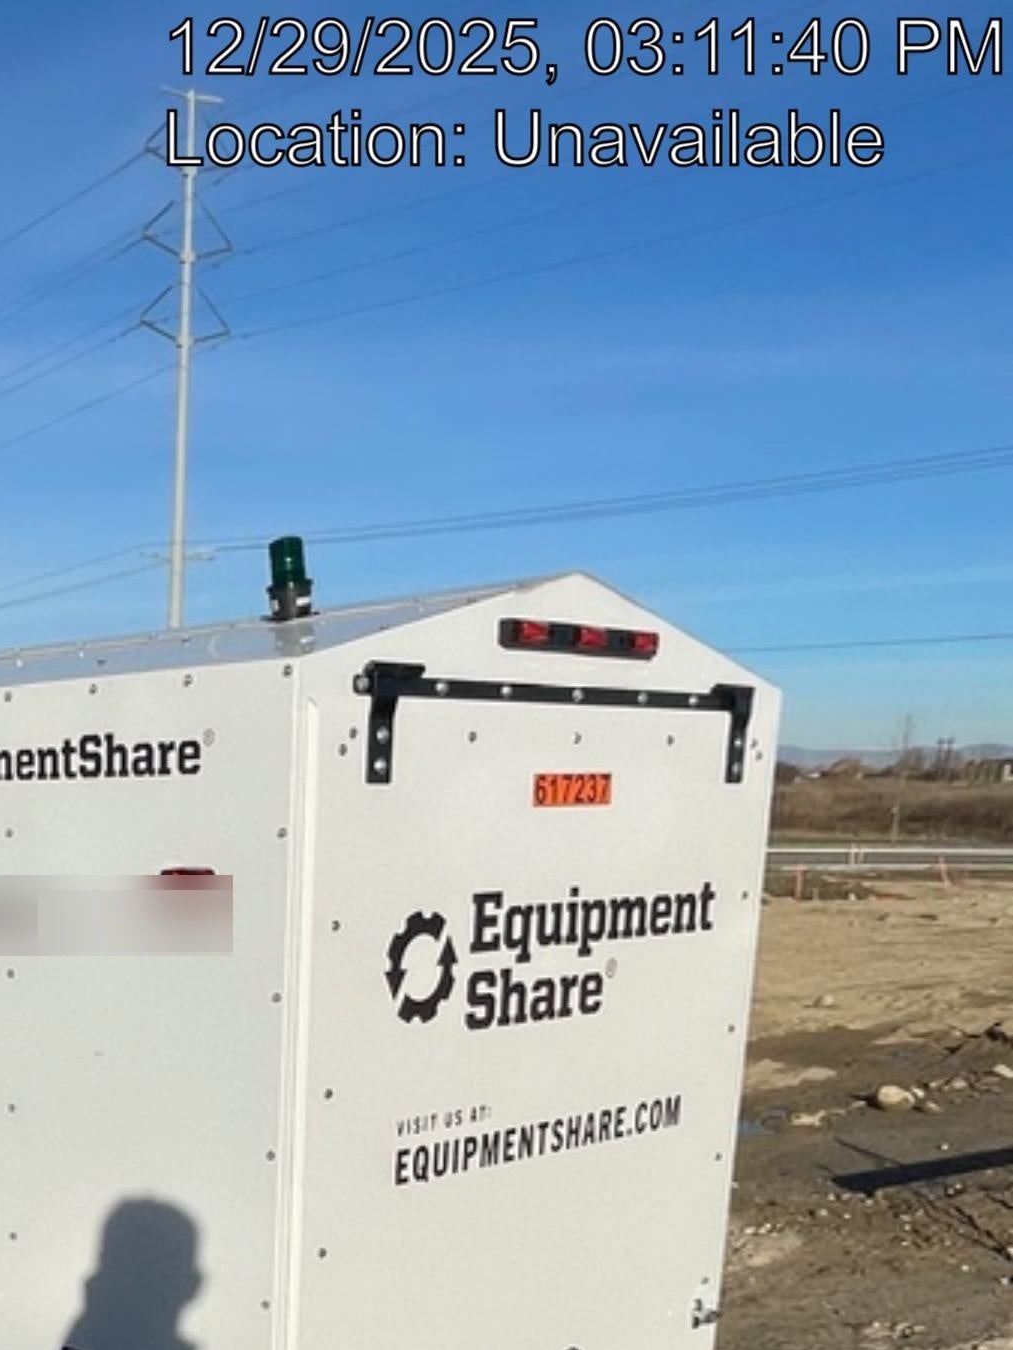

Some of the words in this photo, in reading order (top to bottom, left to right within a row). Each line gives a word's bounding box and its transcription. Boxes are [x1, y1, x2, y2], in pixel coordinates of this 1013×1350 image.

[535, 773, 612, 805] 617237
[470, 881, 716, 963] Equipment
[464, 968, 605, 1031] Share
[394, 1095, 682, 1186] EQUIPMENTSHARE.COM
[396, 1113, 438, 1137] VISIT
[444, 1109, 463, 1129] US
